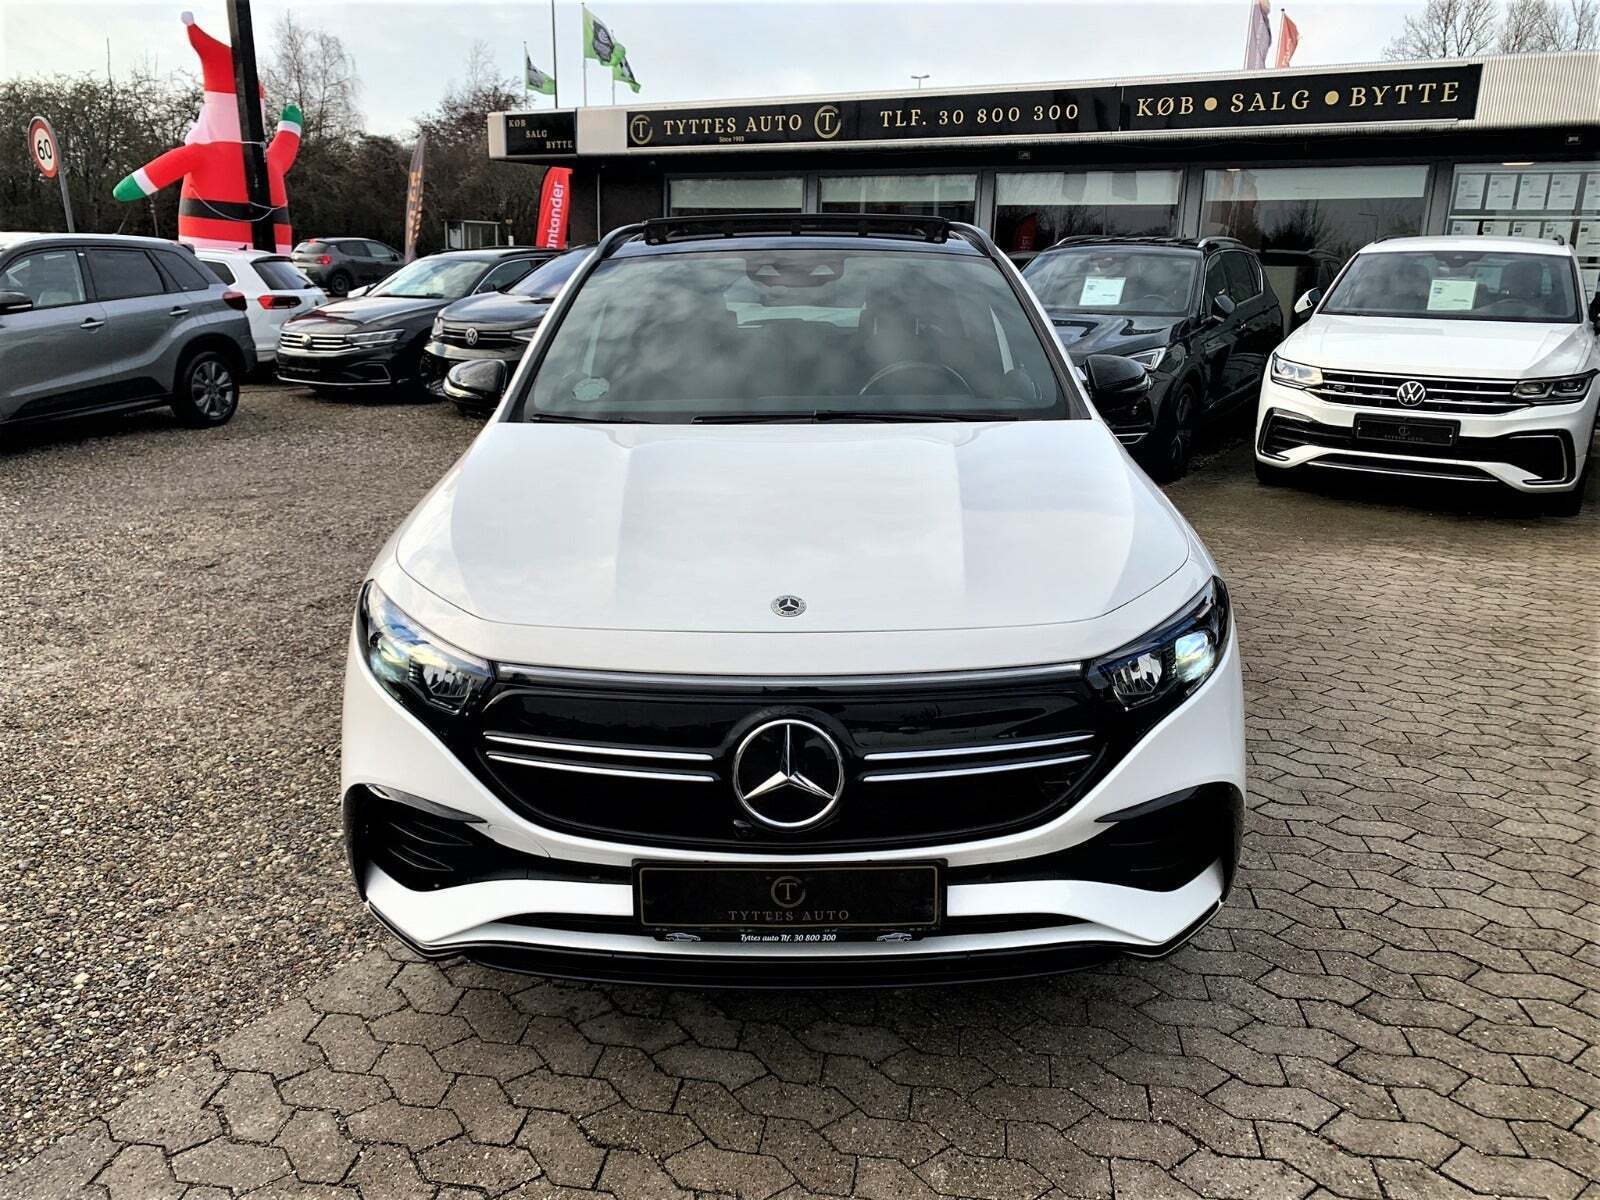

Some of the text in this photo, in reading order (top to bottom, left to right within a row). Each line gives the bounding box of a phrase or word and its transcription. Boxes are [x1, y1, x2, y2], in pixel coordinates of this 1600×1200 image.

[1136, 81, 1460, 116] KØB SALG BYTTE
[663, 113, 803, 136] TYTTES AUTO
[880, 104, 1079, 128] TLF. 30 800 300
[526, 129, 548, 138] SALG
[37, 138, 52, 161] 60
[728, 910, 849, 921] TYTTES AUTO
[740, 934, 761, 943] Tyttes
[794, 934, 804, 942] 30
[805, 934, 820, 942] 800
[821, 934, 837, 942] 300
